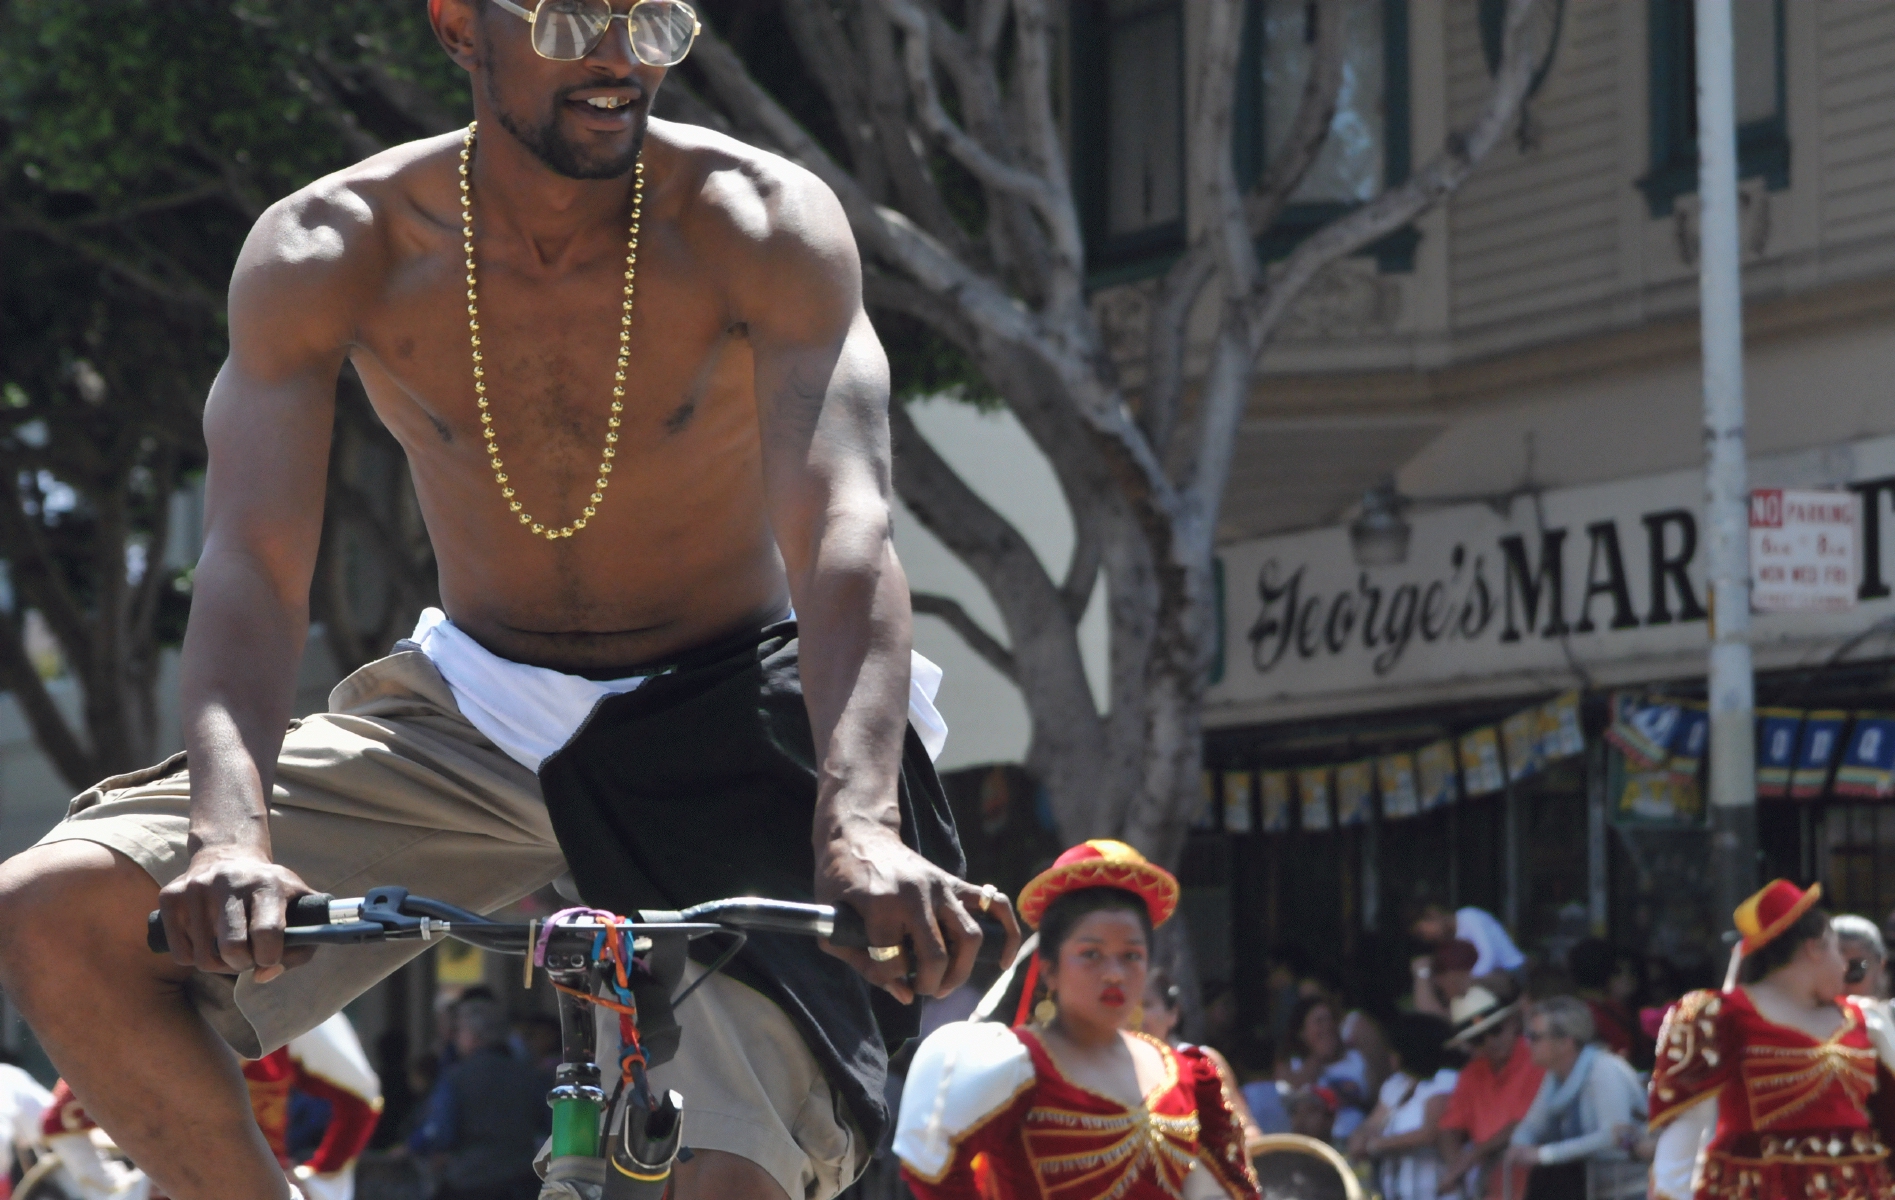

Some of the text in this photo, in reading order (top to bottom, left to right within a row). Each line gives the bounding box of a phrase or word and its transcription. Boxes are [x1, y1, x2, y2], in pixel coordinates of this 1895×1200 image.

[1751, 494, 1852, 525] NO PARKING
[1248, 475, 1895, 677] George's MART
